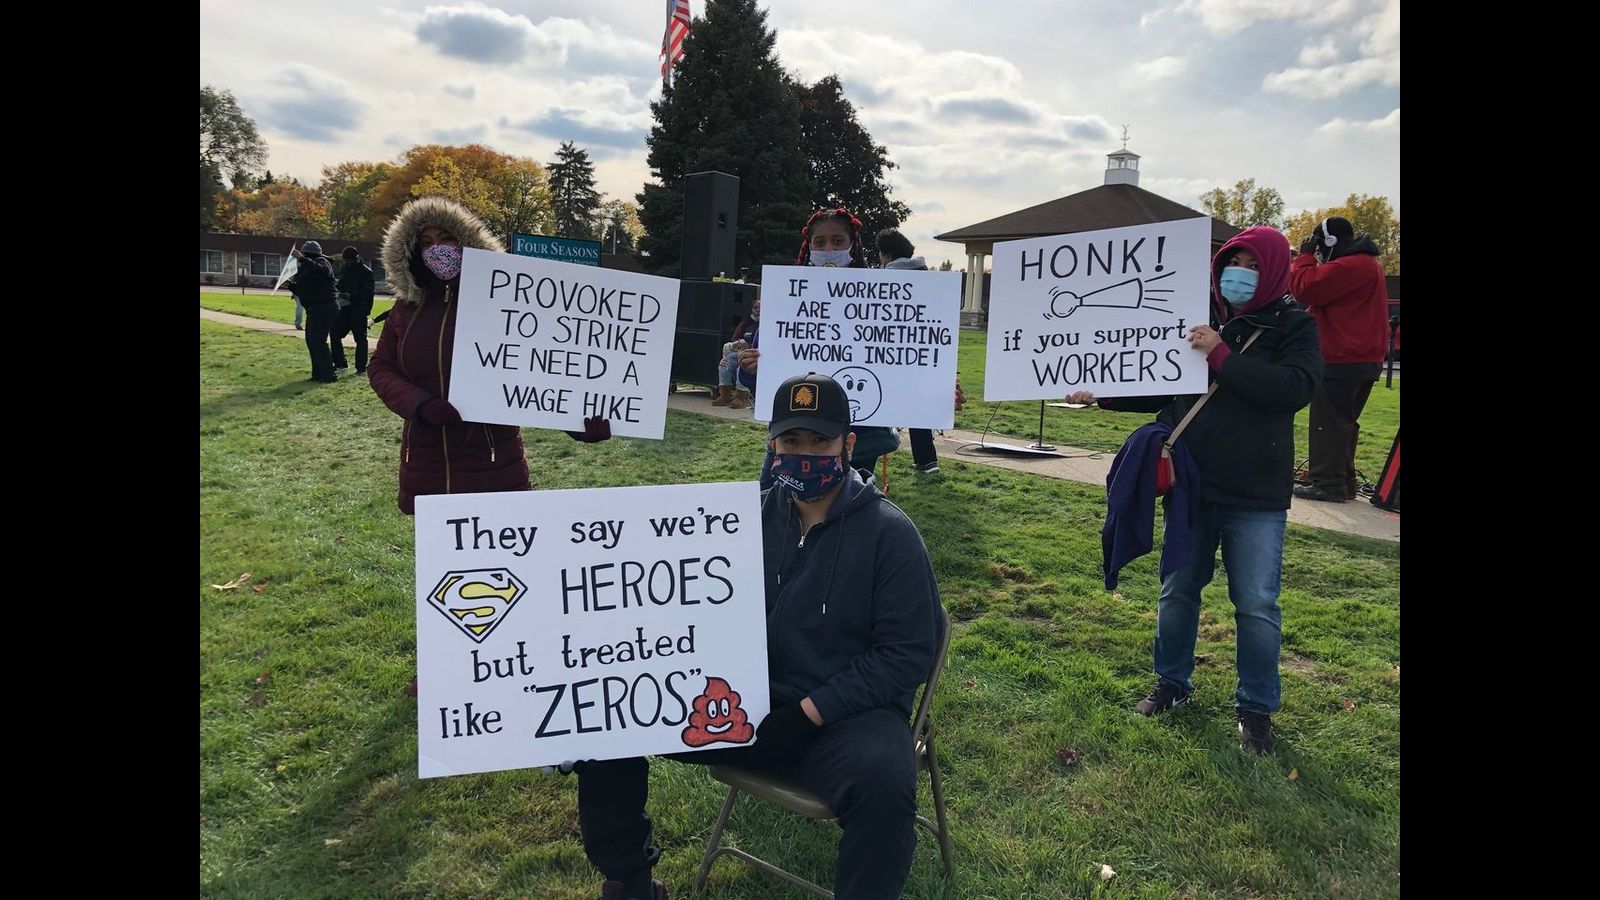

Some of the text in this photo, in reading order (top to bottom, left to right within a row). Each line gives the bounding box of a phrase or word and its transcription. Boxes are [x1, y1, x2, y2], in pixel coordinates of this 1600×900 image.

[515, 237, 549, 255] FOUR
[549, 240, 600, 259] SEASONS
[1020, 236, 1166, 281] HONK!
[489, 270, 660, 324] PROVOKED
[788, 279, 913, 300] IF WORKERS
[500, 308, 650, 355] TO STRIKE
[796, 301, 942, 323] ARE OUTSIDE...
[776, 321, 951, 345] THERE'S SOMETHING
[1003, 318, 1186, 353] if you support
[474, 341, 640, 386] WE NEED A
[791, 343, 939, 367] WRONG INSIDE!
[1032, 349, 1183, 387] WORKERS
[502, 383, 643, 423] WAGE HIKE
[447, 507, 740, 556] They say we're
[561, 556, 734, 615] HEROES
[471, 625, 696, 683] but treated
[439, 702, 503, 739] like
